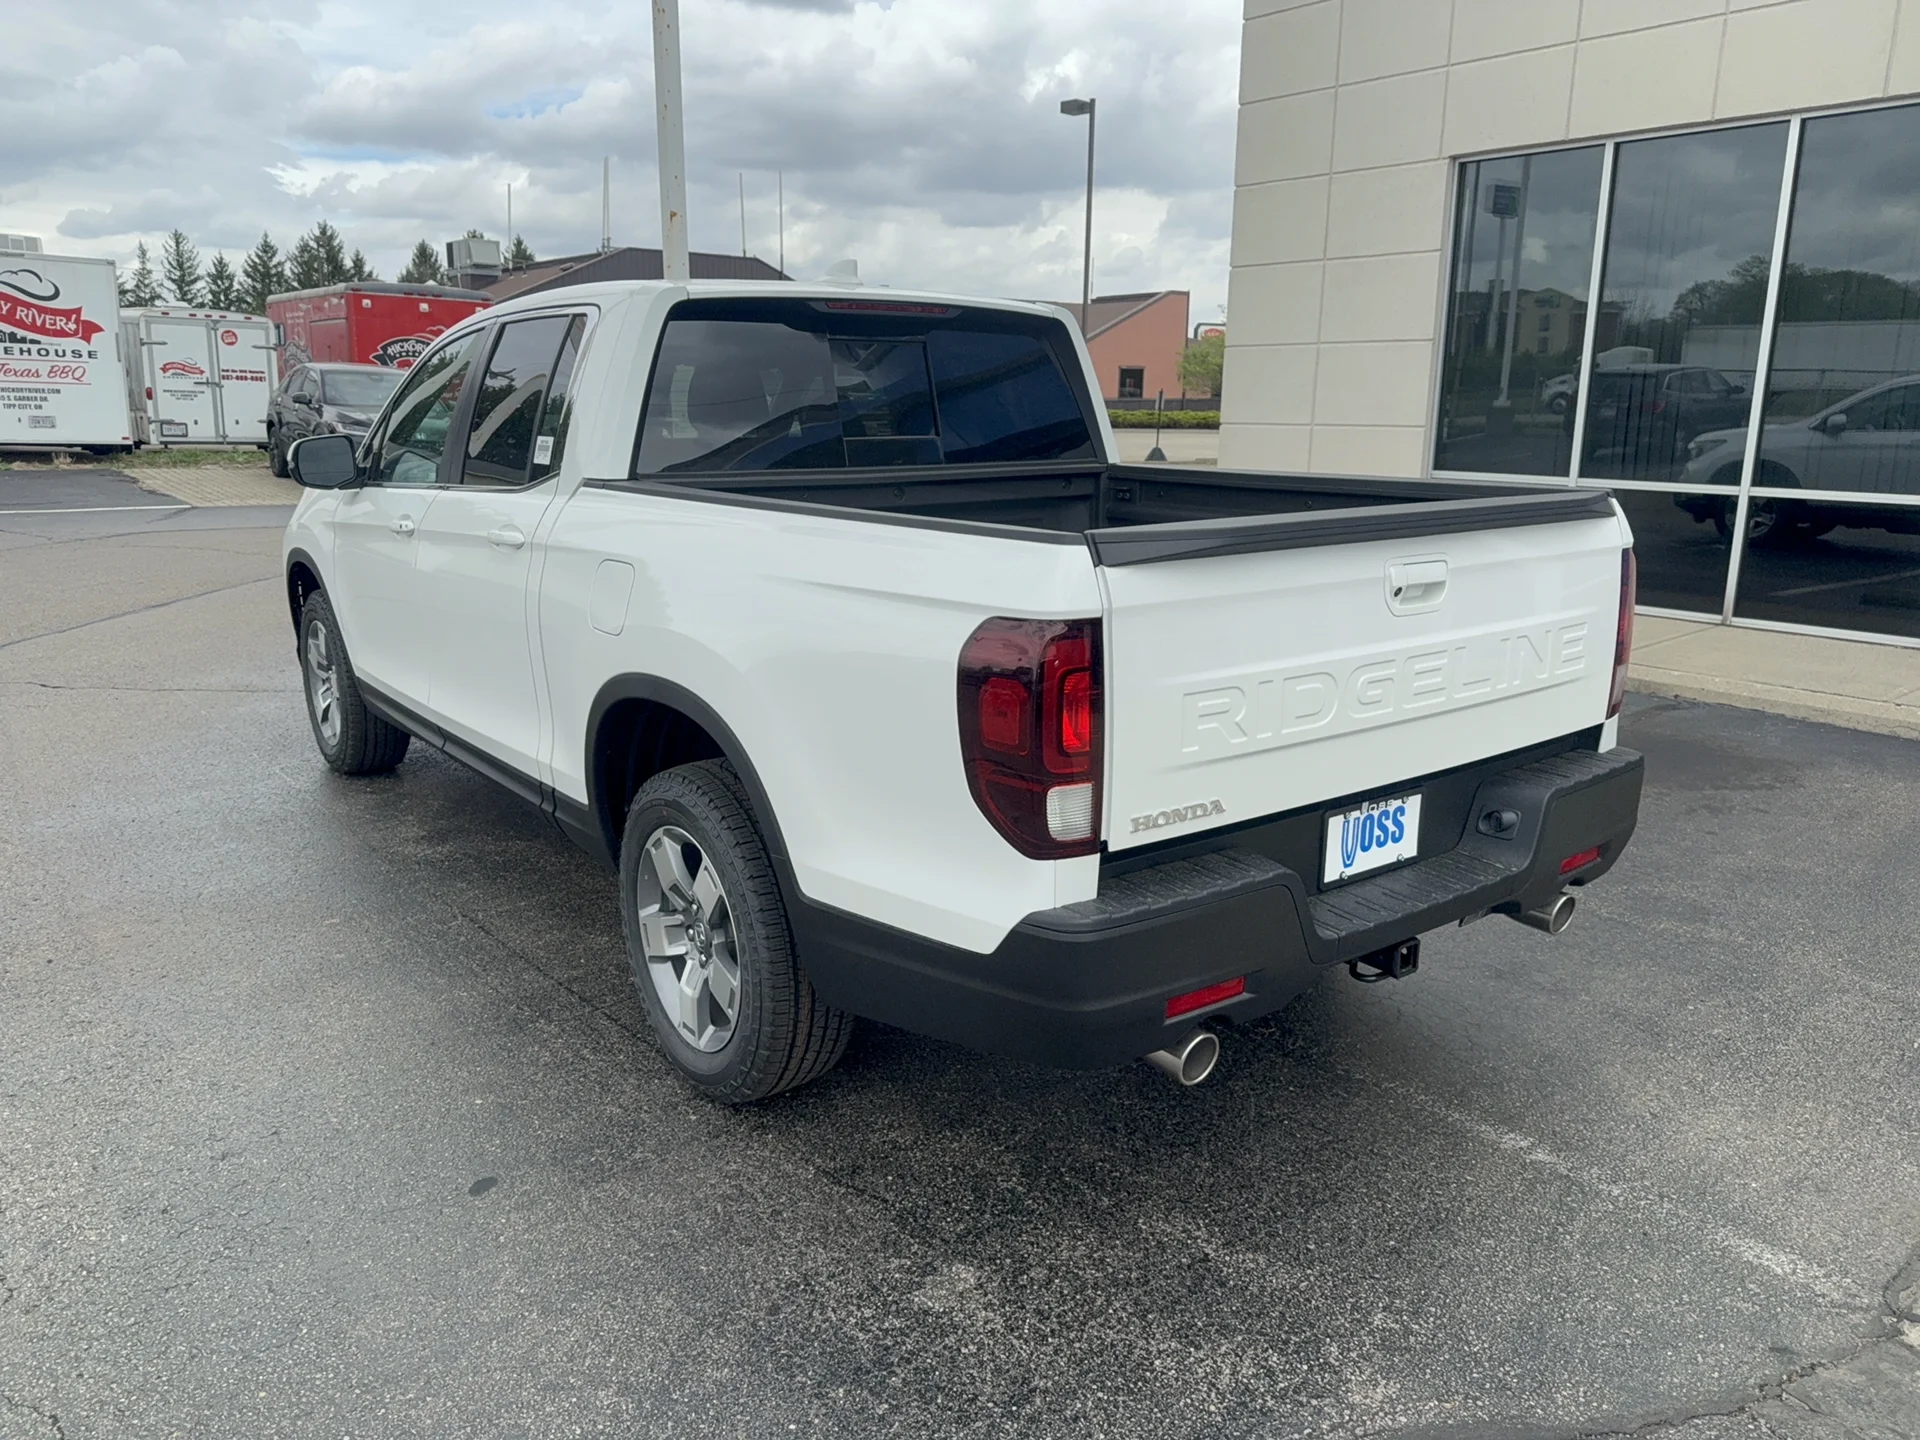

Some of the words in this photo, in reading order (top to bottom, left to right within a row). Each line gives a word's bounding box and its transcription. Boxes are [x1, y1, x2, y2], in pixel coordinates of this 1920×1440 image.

[47, 365, 86, 382] BBQ
[1182, 621, 1588, 752] RIDGELINE
[1129, 798, 1226, 834] HONDA
[1341, 805, 1406, 869] VOSS
